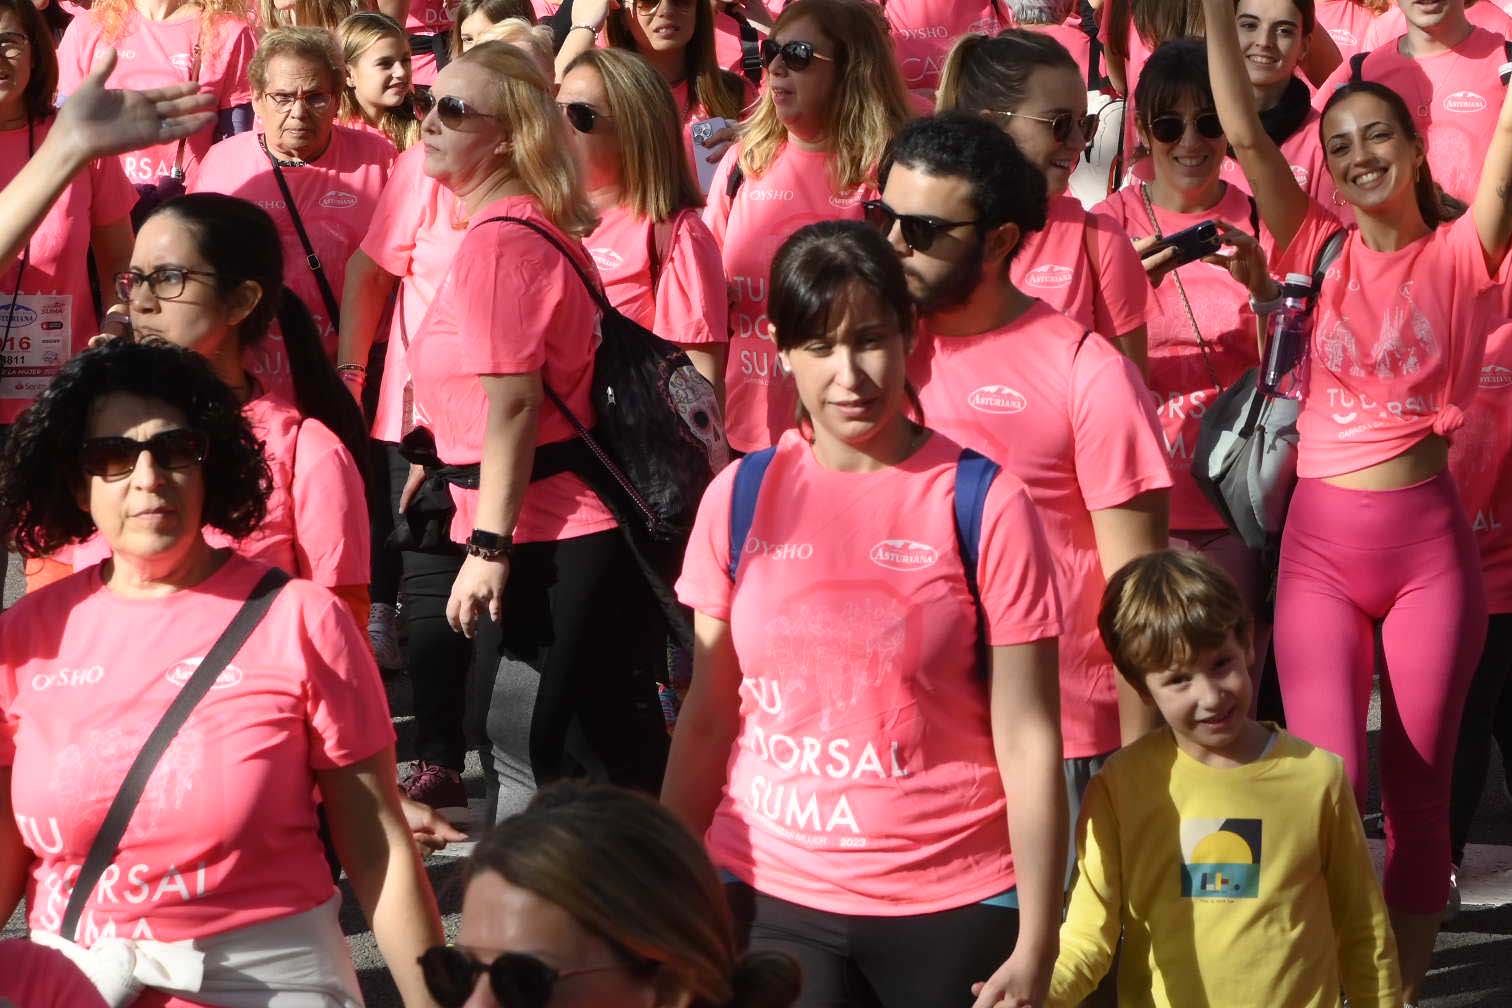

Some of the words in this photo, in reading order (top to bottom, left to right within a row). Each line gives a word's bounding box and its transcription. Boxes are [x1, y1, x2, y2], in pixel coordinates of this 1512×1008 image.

[125, 156, 170, 180] RSA
[734, 276, 764, 301] TU
[1472, 509, 1501, 532] AL
[744, 536, 813, 561] OYSHO
[876, 547, 932, 565] ASTURIANA
[32, 665, 104, 690] OSHO
[751, 725, 909, 778] DORSAL
[746, 775, 860, 833] SUMA
[840, 837, 867, 848] 2023
